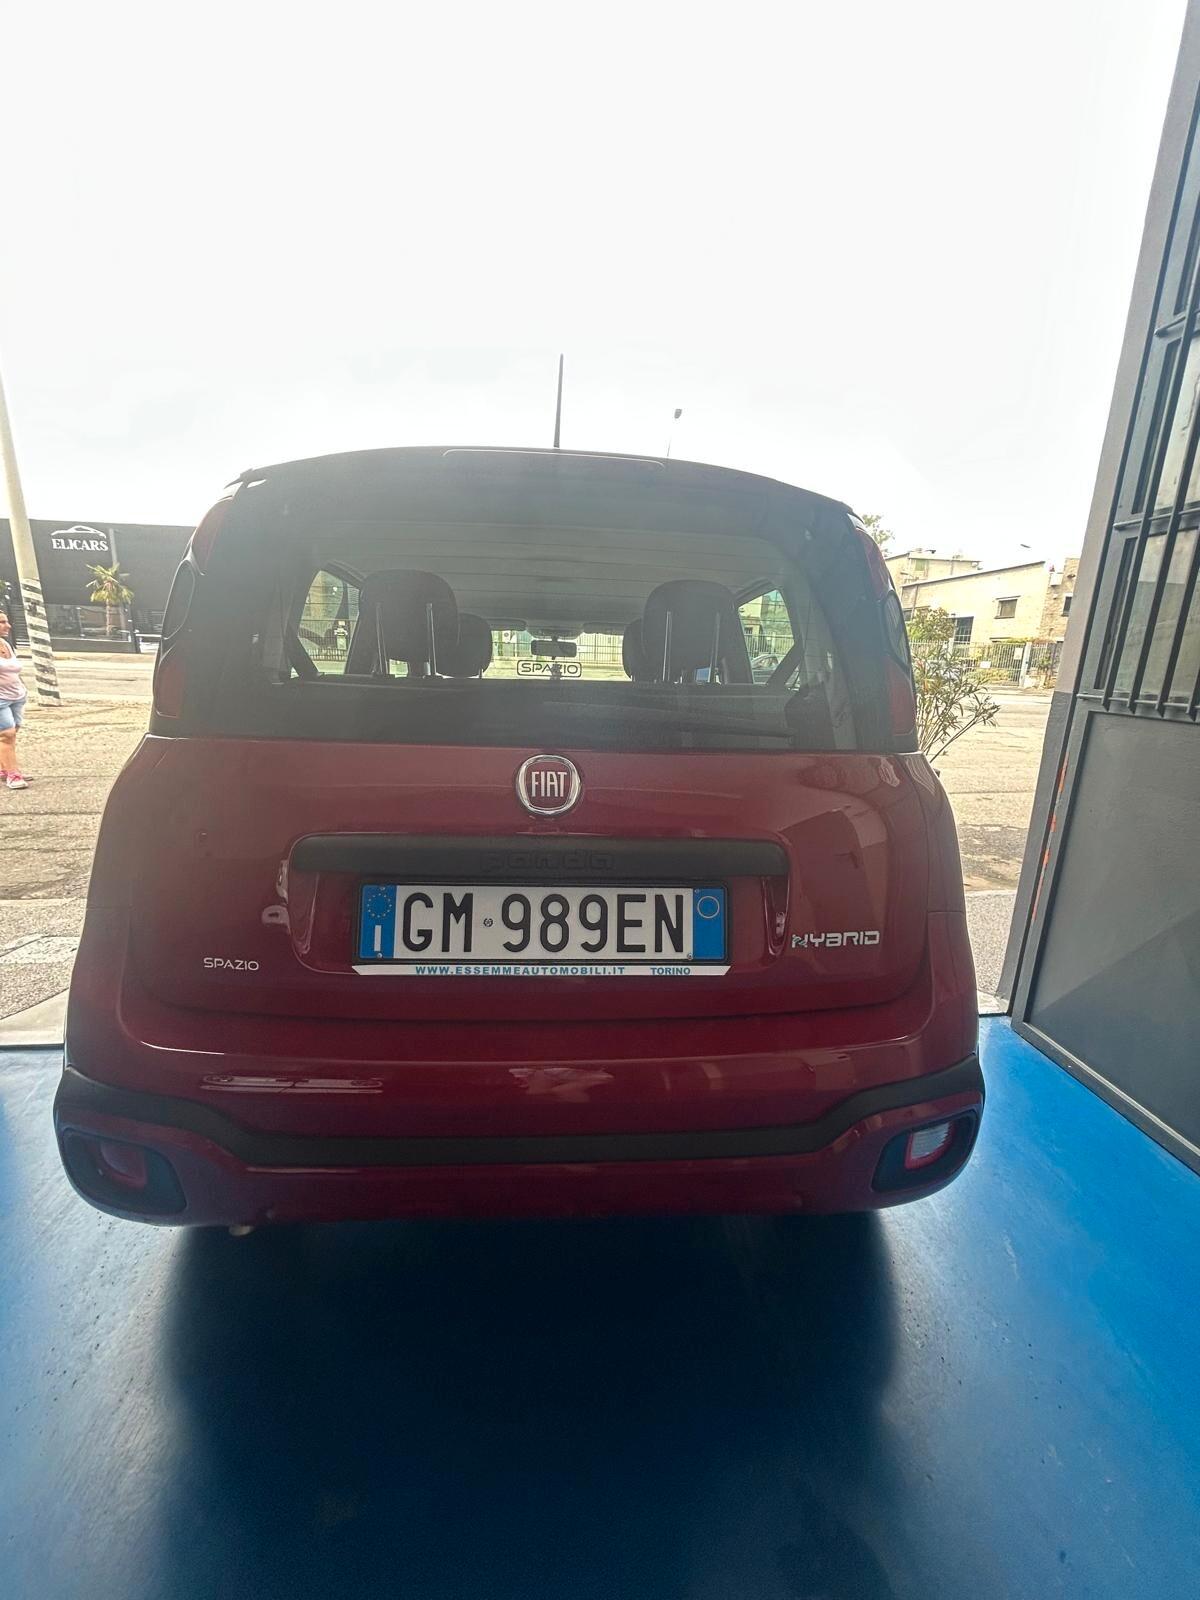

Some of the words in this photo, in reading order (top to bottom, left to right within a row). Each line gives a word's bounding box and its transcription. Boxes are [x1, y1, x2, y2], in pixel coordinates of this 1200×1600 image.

[51, 538, 109, 551] ELICARS
[531, 771, 567, 798] FIAT
[402, 892, 474, 953] GM
[501, 893, 684, 953] 989EN
[791, 930, 880, 948] HYBRID
[203, 957, 259, 971] SPAZIO
[415, 965, 625, 975] WWW.ESSEMMEAUTOMOBILI.IT
[650, 967, 691, 975] TORINO
